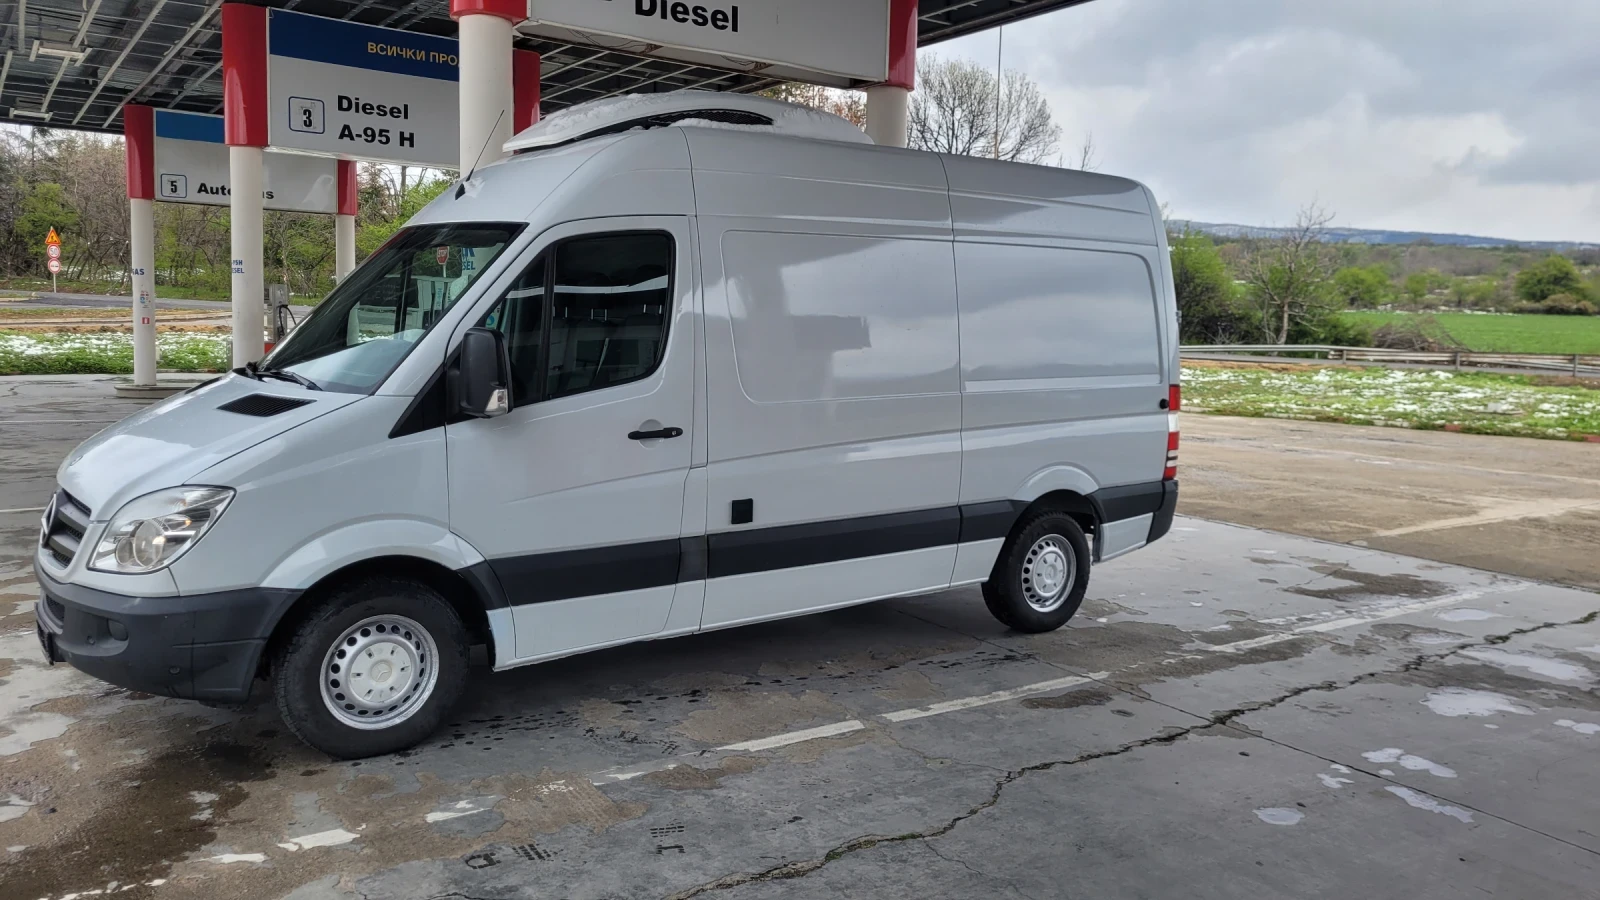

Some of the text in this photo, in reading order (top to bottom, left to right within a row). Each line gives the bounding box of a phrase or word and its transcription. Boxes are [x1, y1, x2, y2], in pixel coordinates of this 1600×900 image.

[635, 0, 738, 32] Diesel
[367, 41, 459, 66] ВСИЧКИ ПРО
[303, 109, 312, 127] 3
[337, 94, 409, 120] Diesel
[337, 123, 415, 148] A-95 H
[170, 181, 177, 193] 5
[462, 261, 475, 270] SEL
